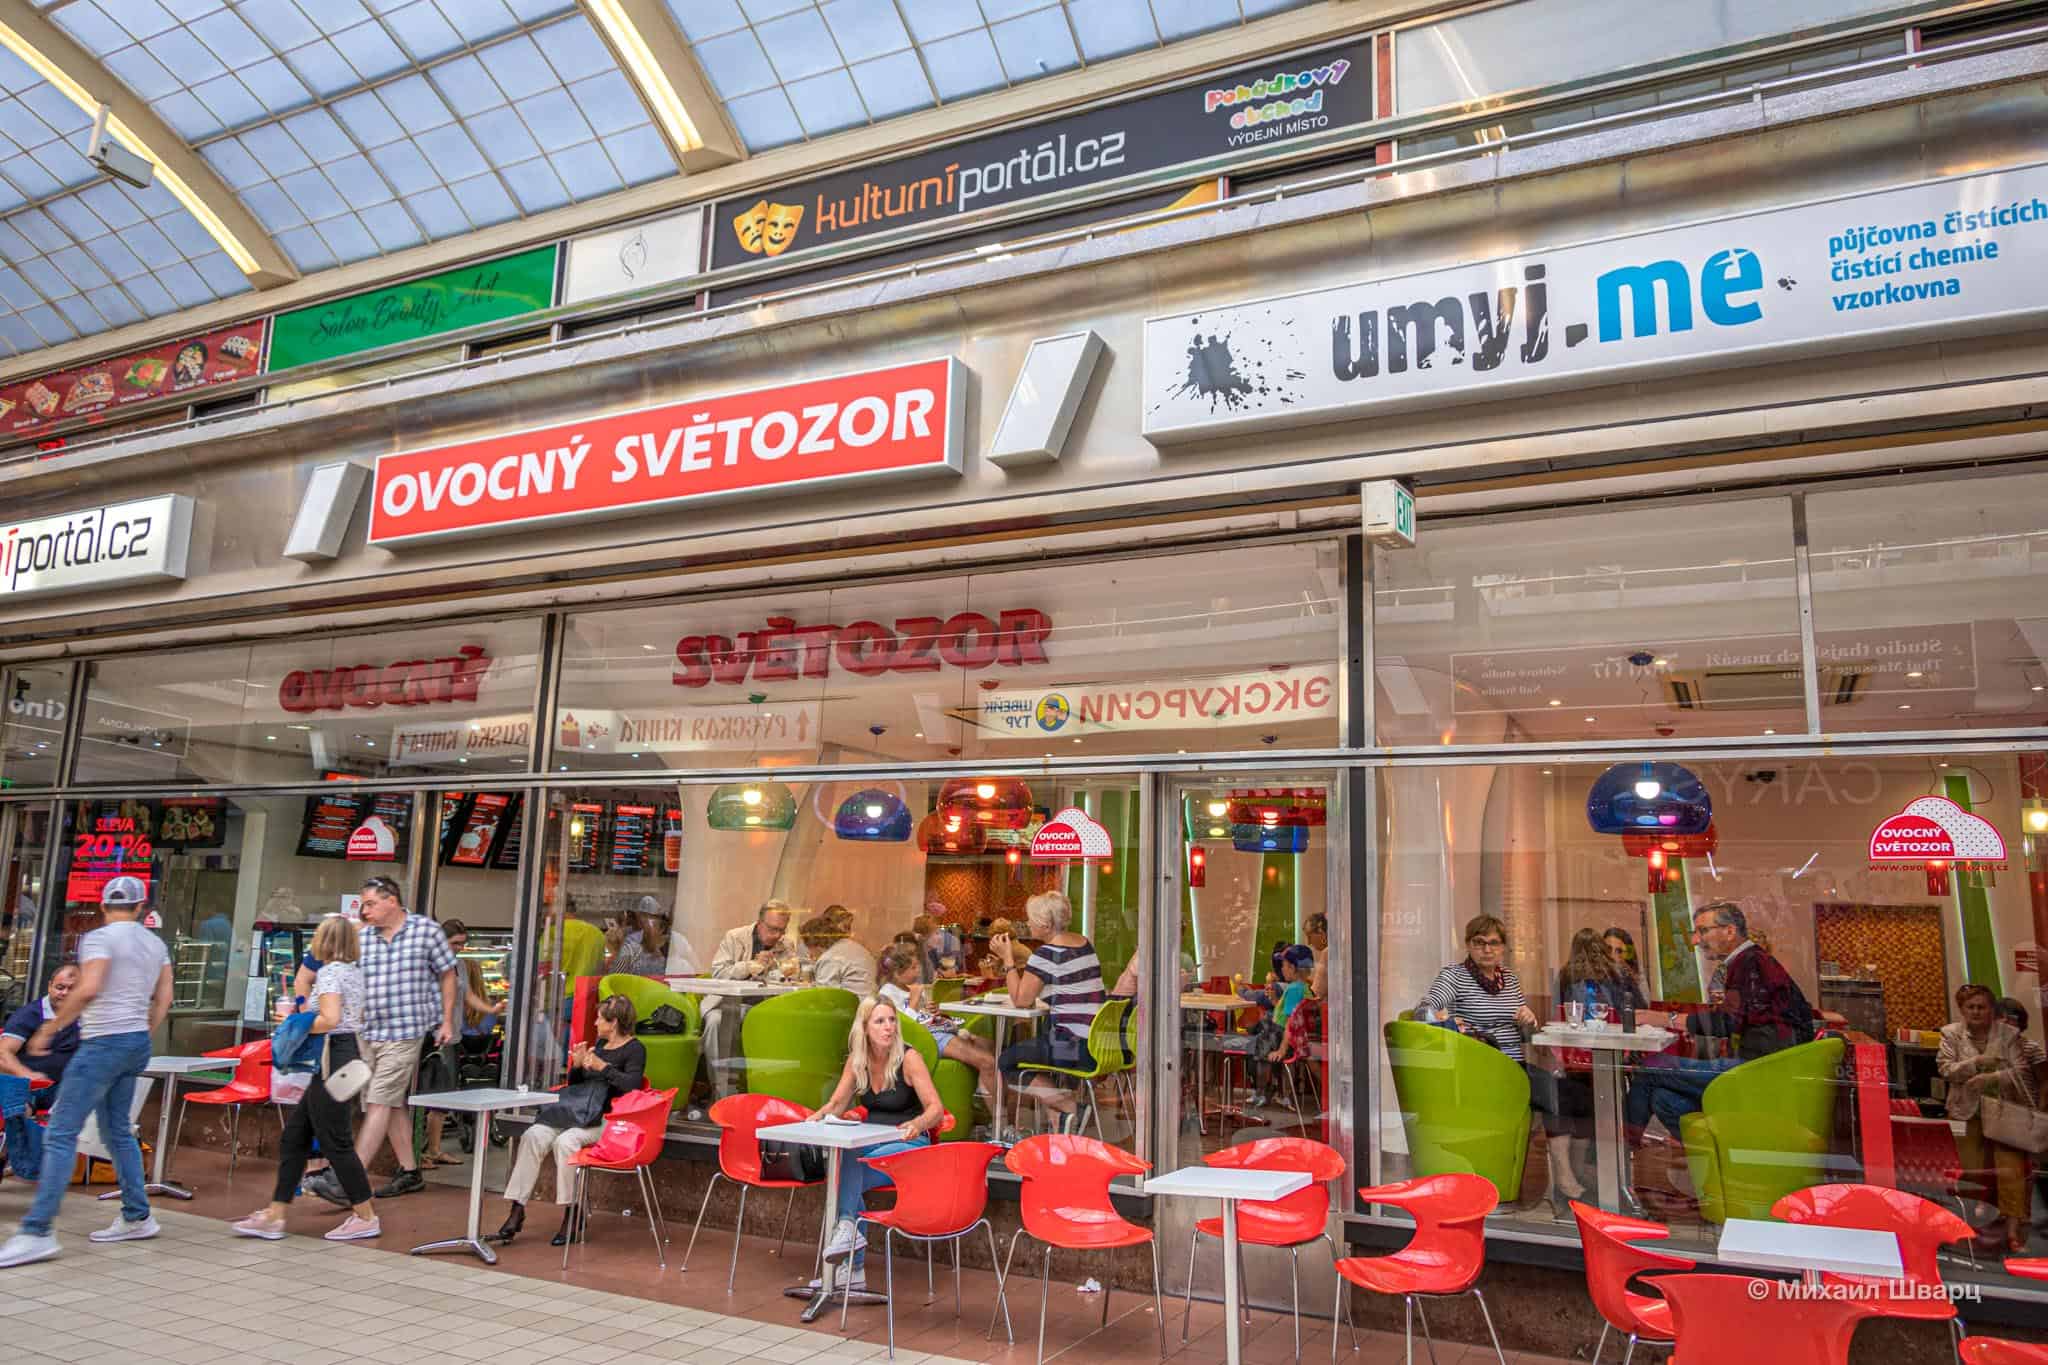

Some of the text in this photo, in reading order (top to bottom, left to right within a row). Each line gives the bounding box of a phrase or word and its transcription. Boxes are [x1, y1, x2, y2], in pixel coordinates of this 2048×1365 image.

[1230, 90, 1323, 129] obchod
[1228, 115, 1328, 147] VÝDEJNÍ MÍSTO
[816, 130, 1125, 235] kulturníportál.cz
[1829, 198, 2048, 257] půjčovna čistících
[1831, 238, 1998, 282] čistící chemie
[1832, 277, 1960, 311] vzorkovna
[381, 388, 935, 517] OVOCNÝ SVĚTOZOR
[0, 507, 152, 591] íportál.cz
[672, 609, 1053, 688] SVĚTOZOR
[95, 817, 136, 832] SLEVA
[1881, 827, 1942, 838] OVOCNÝ
[1875, 840, 1951, 853] SVĚTOZOR
